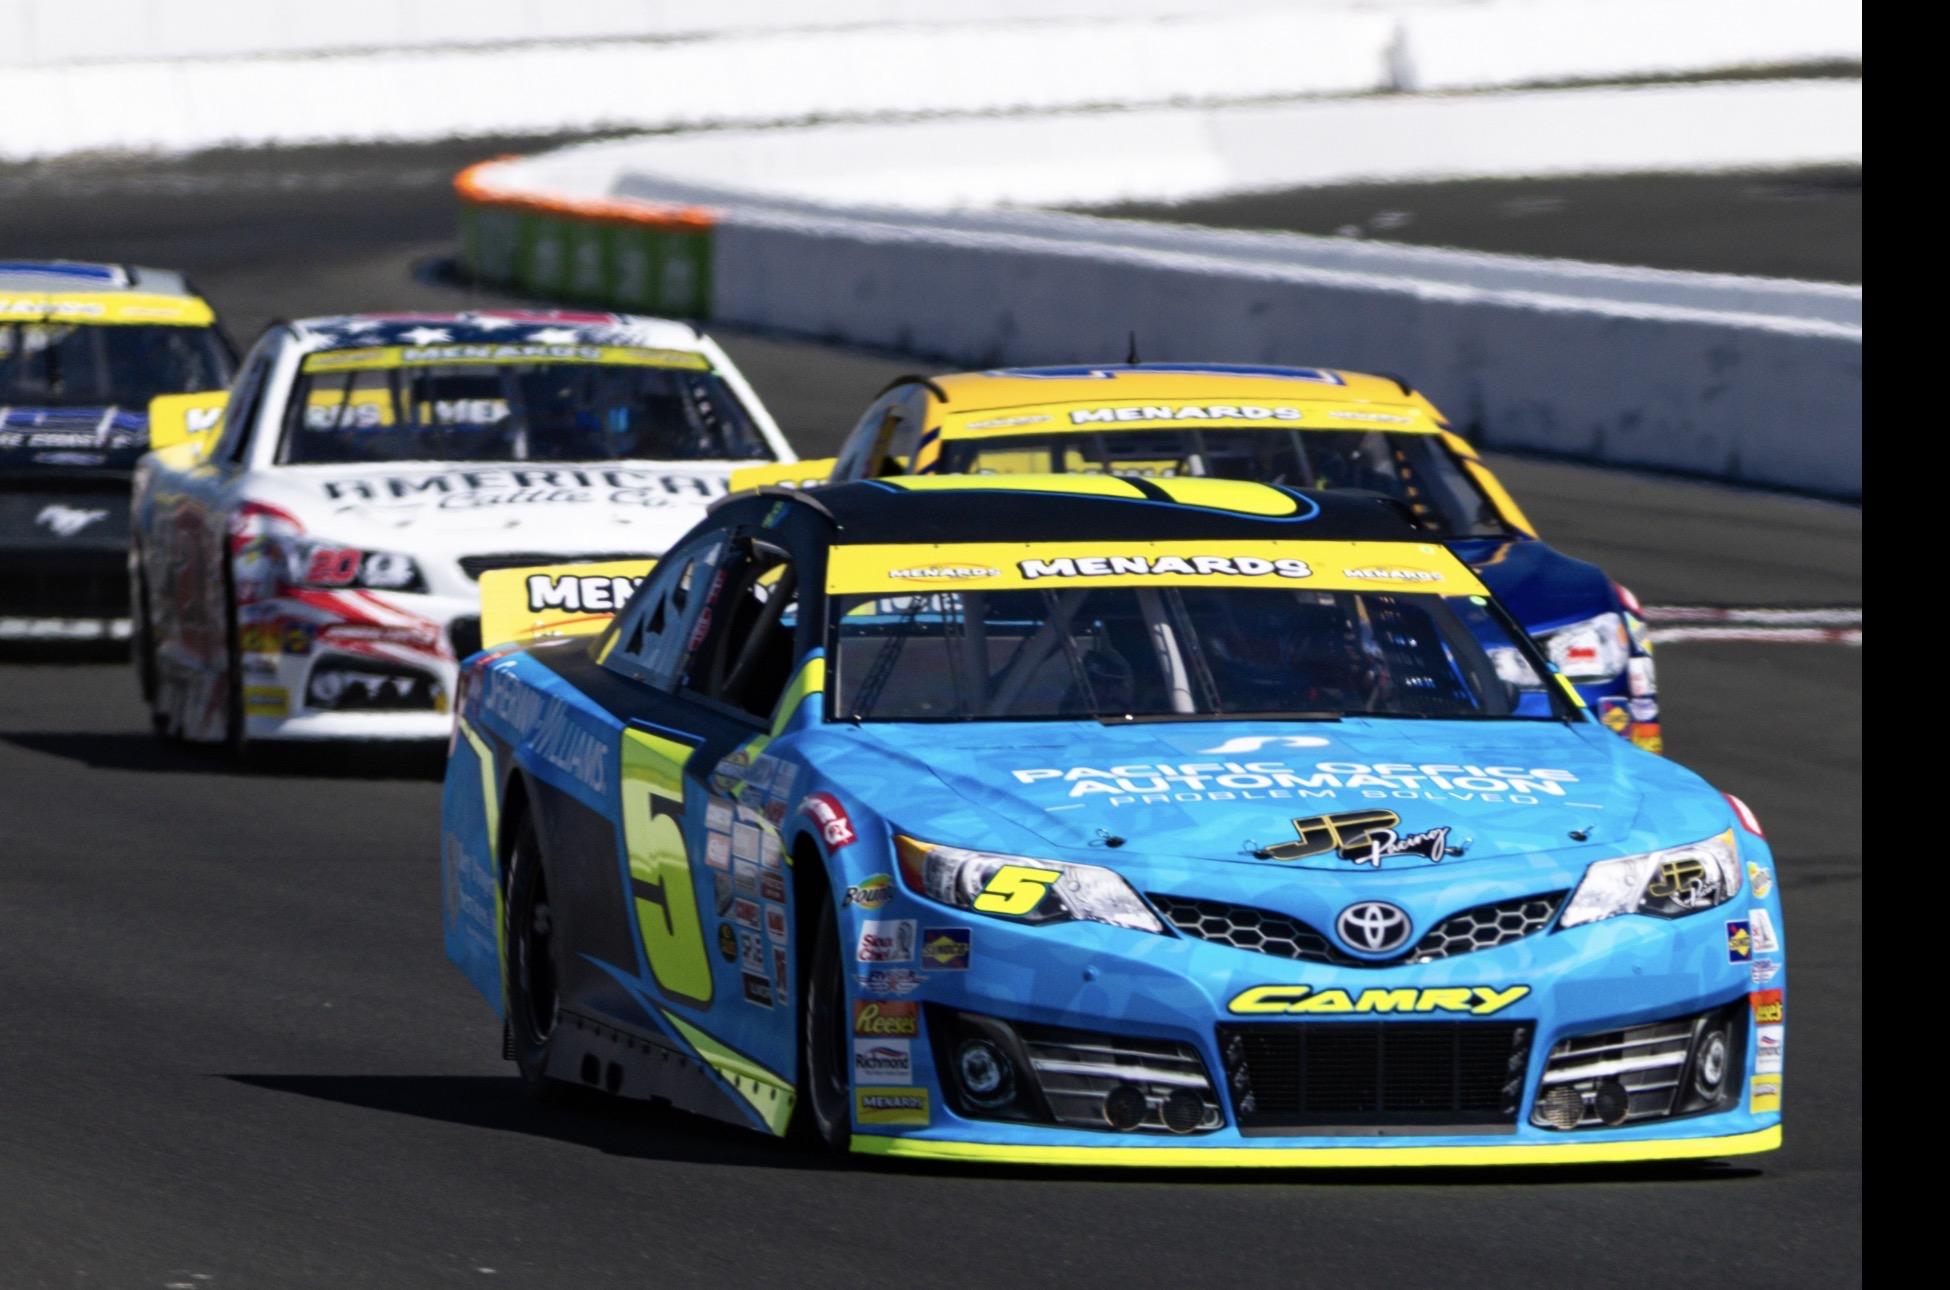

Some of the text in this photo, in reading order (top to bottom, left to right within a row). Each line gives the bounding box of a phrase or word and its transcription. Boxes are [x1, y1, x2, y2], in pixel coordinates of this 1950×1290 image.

[1069, 406, 1302, 424] MENARDS
[322, 471, 731, 499] AMERICA
[306, 546, 362, 583] 20
[889, 566, 1001, 579] MENARDS
[1017, 556, 1313, 579] MENARDS
[1344, 567, 1444, 582] MENARDS
[1011, 762, 1579, 783] PACIFIC OFFICE
[1068, 773, 1567, 797] AUTOMATION
[1110, 788, 1539, 807] PROBLEM SOLVED
[1345, 828, 1451, 866] Racing
[620, 727, 713, 1007] 5
[973, 864, 1062, 916] 5
[1227, 984, 1531, 1015] CAMRY
